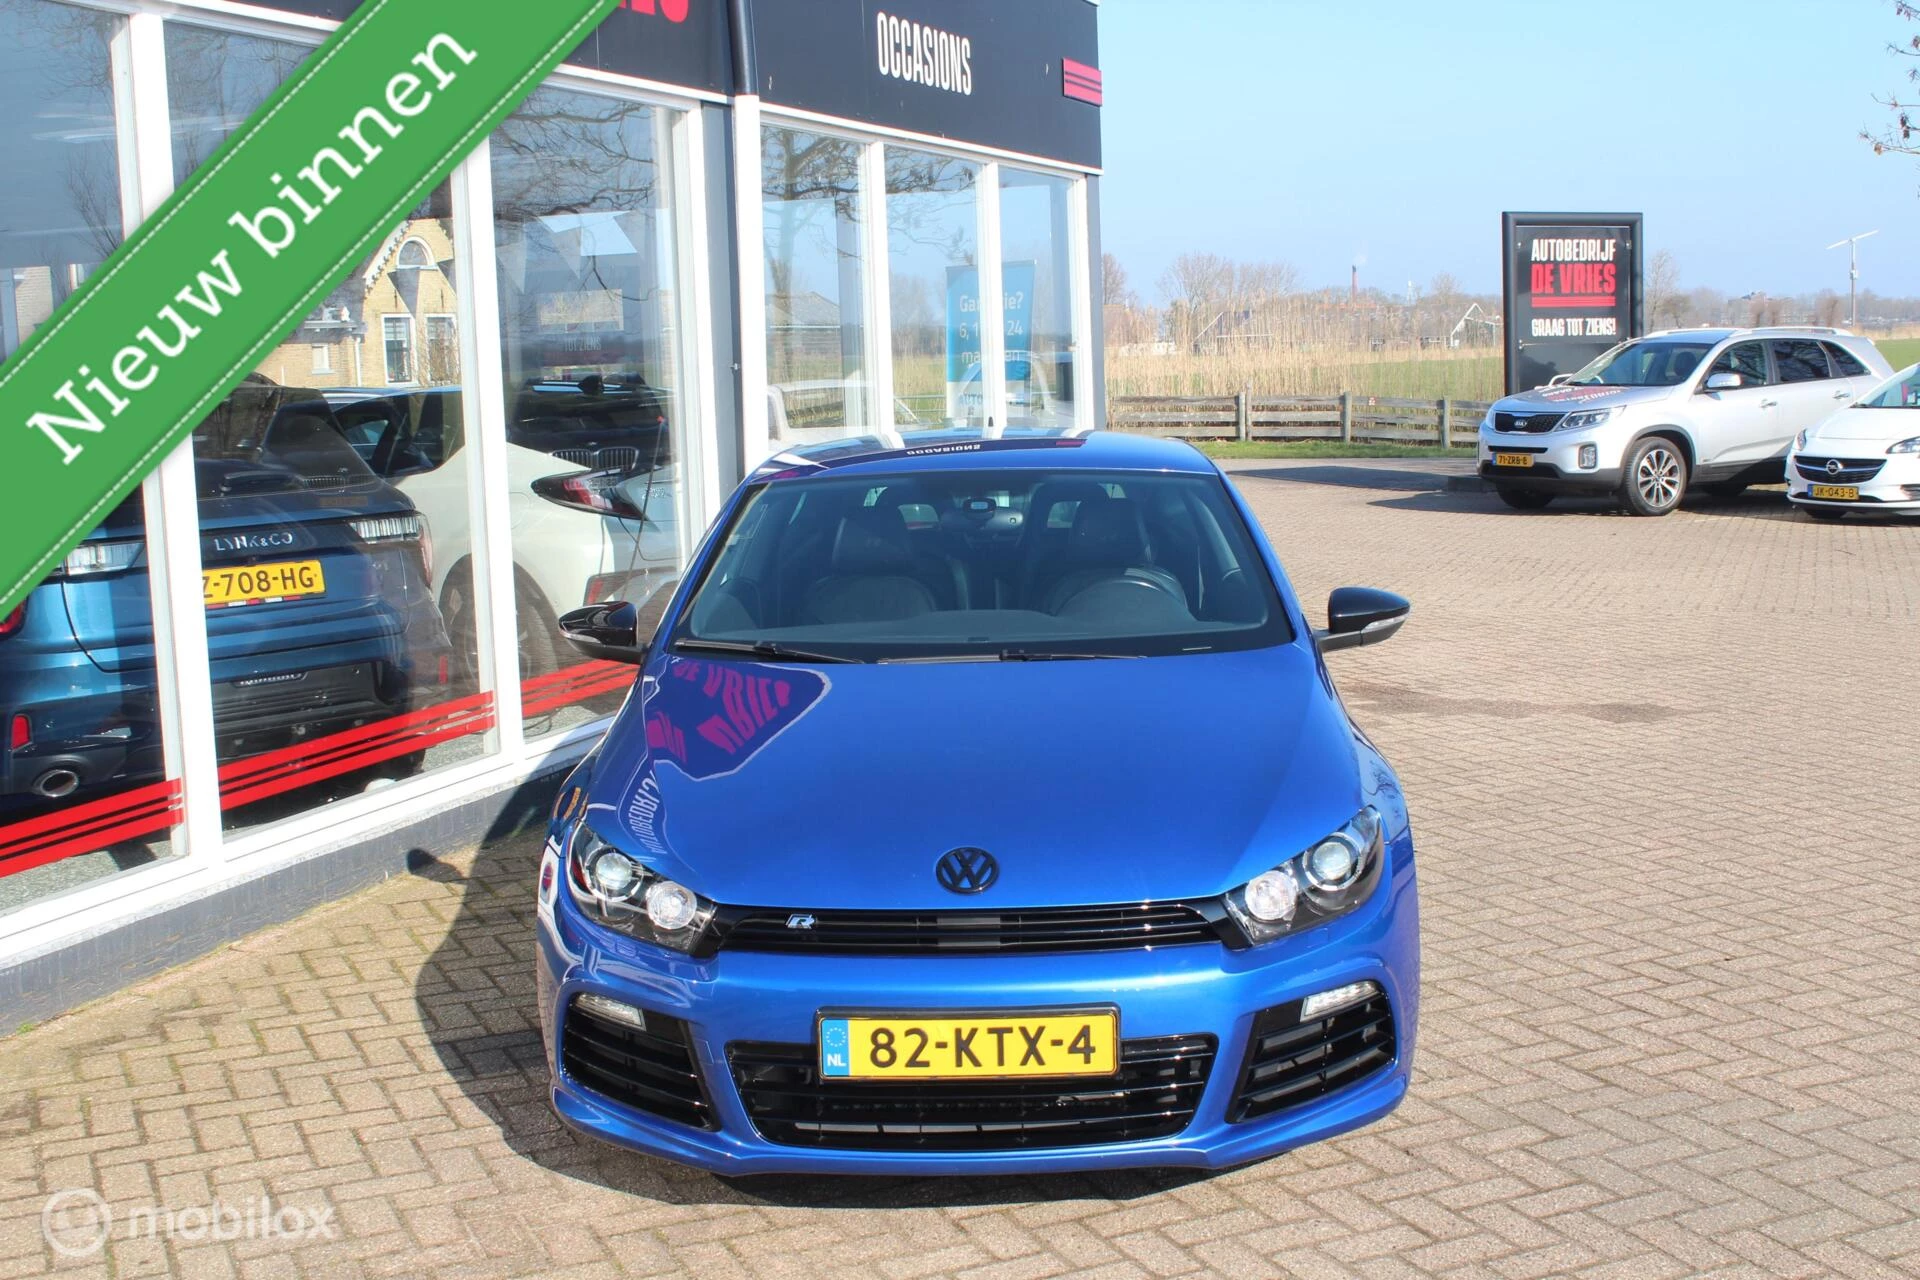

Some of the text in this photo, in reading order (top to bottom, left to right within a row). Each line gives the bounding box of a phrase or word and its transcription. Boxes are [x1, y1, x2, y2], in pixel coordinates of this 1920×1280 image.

[877, 11, 972, 96] OCCASIONS
[1531, 238, 1616, 262] AUTOBEDRIJF
[1531, 263, 1616, 294] DE VRIES
[1007, 320, 1023, 336] 24
[1531, 317, 1616, 336] GRAAG TOT ZIENS!
[870, 1025, 1096, 1068] 82-KTX-4
[827, 1054, 846, 1067] NL
